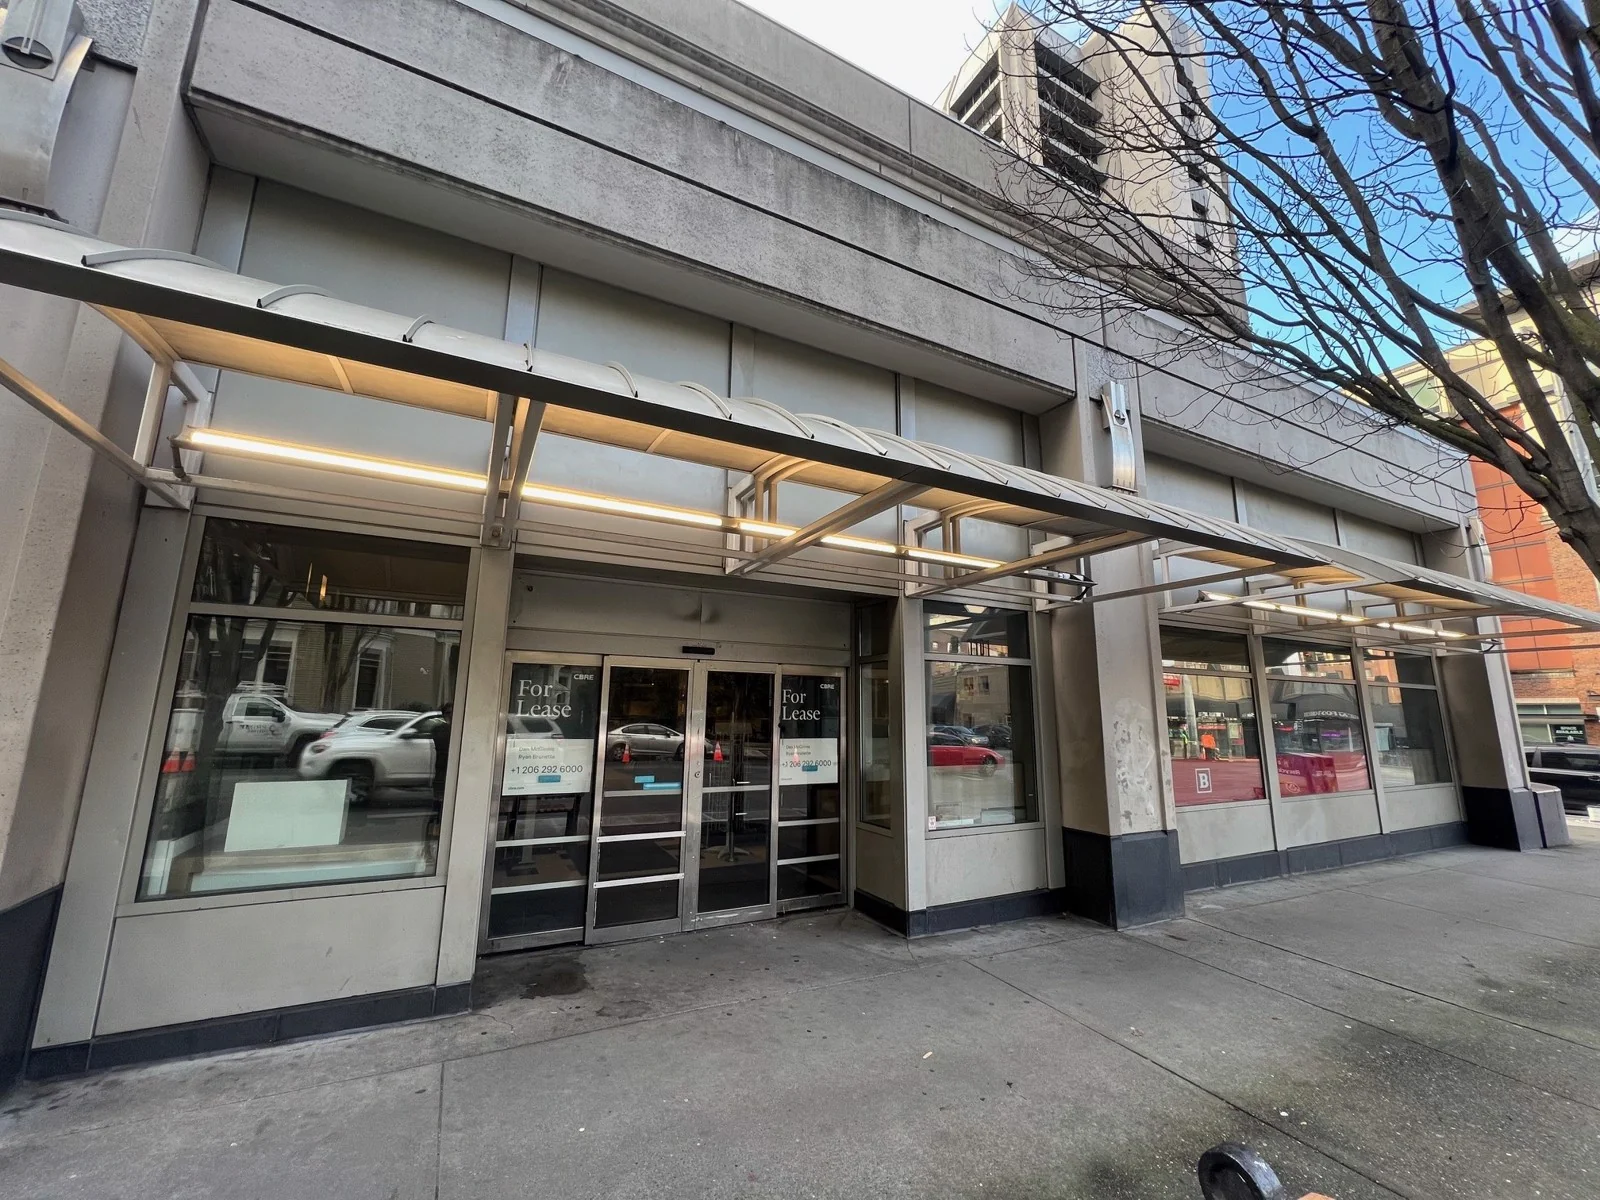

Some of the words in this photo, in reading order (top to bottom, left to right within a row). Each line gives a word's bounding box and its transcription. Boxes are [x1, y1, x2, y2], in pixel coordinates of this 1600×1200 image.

[573, 673, 594, 681] CBRE
[518, 679, 553, 697] For
[782, 689, 807, 704] For
[516, 700, 572, 718] Lease
[782, 706, 821, 720] Lease
[522, 766, 540, 774] 206
[542, 765, 558, 774] 292
[560, 764, 582, 773] 6000
[1198, 773, 1209, 788] B
